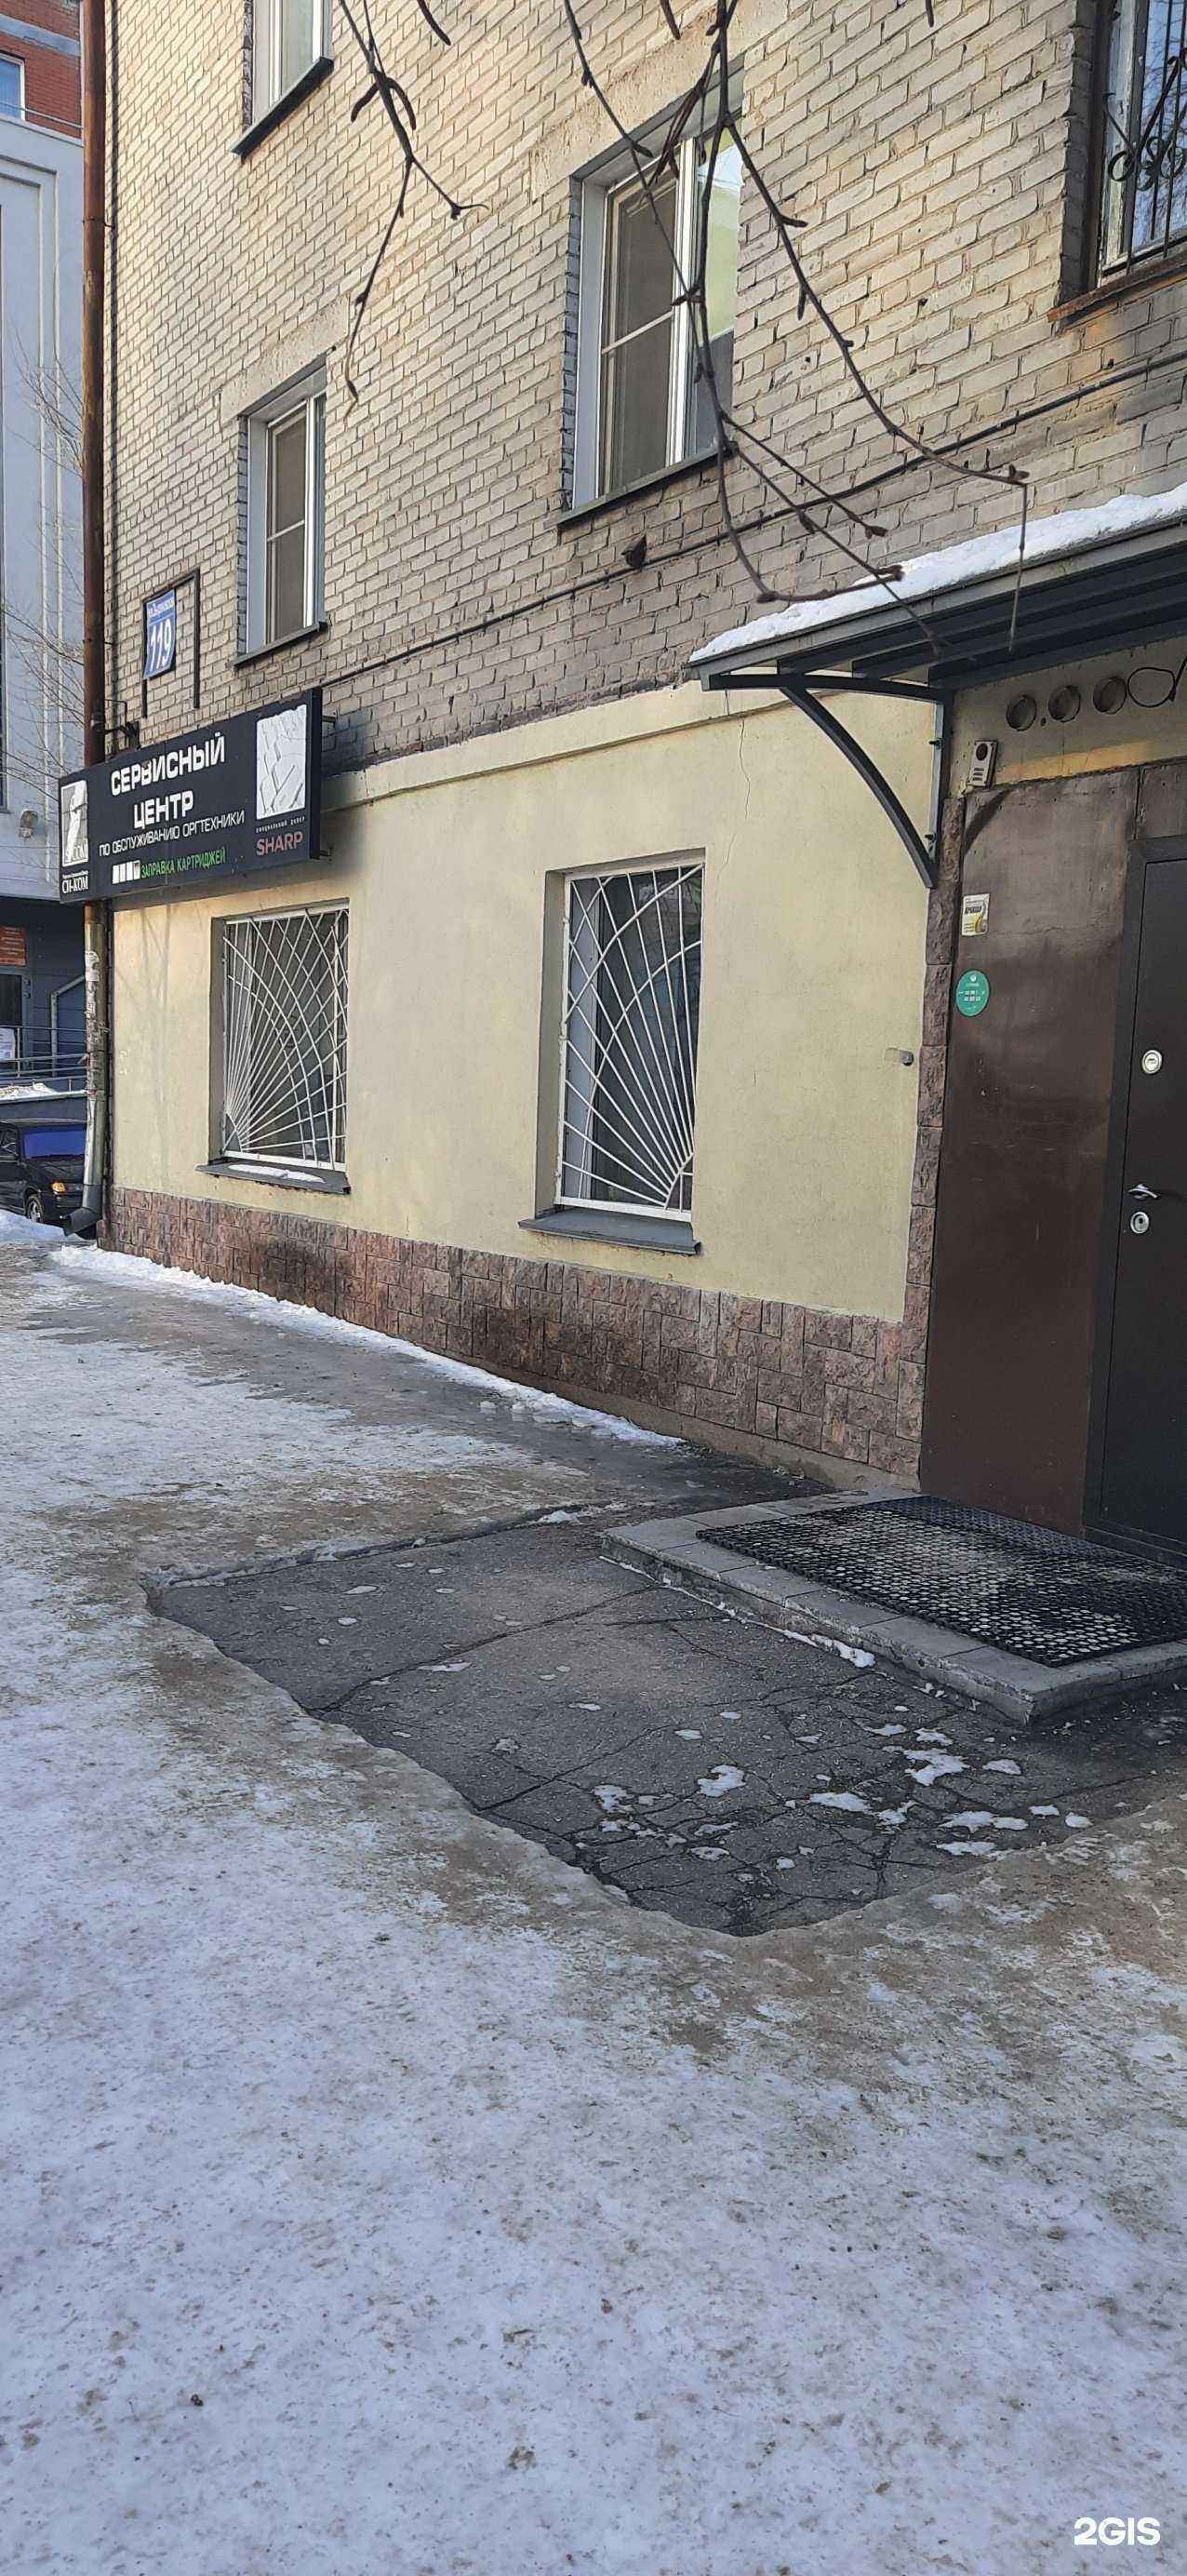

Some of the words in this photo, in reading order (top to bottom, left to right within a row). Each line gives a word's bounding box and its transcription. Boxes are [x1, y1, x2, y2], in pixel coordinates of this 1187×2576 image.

[150, 618, 172, 672] 119
[111, 731, 225, 797] СЕРВИСНЫЙ
[133, 790, 193, 829] ЦЕНТР
[99, 843, 111, 857] ПО
[112, 825, 180, 853] ОБСЛУЖИВАНИЮ
[182, 810, 245, 838] ОРГТЕХНИКИ
[256, 831, 303, 856] SHARP
[140, 859, 176, 879] ЗАПРАВКА
[177, 846, 226, 873] КАРТРИДЖЕЙ
